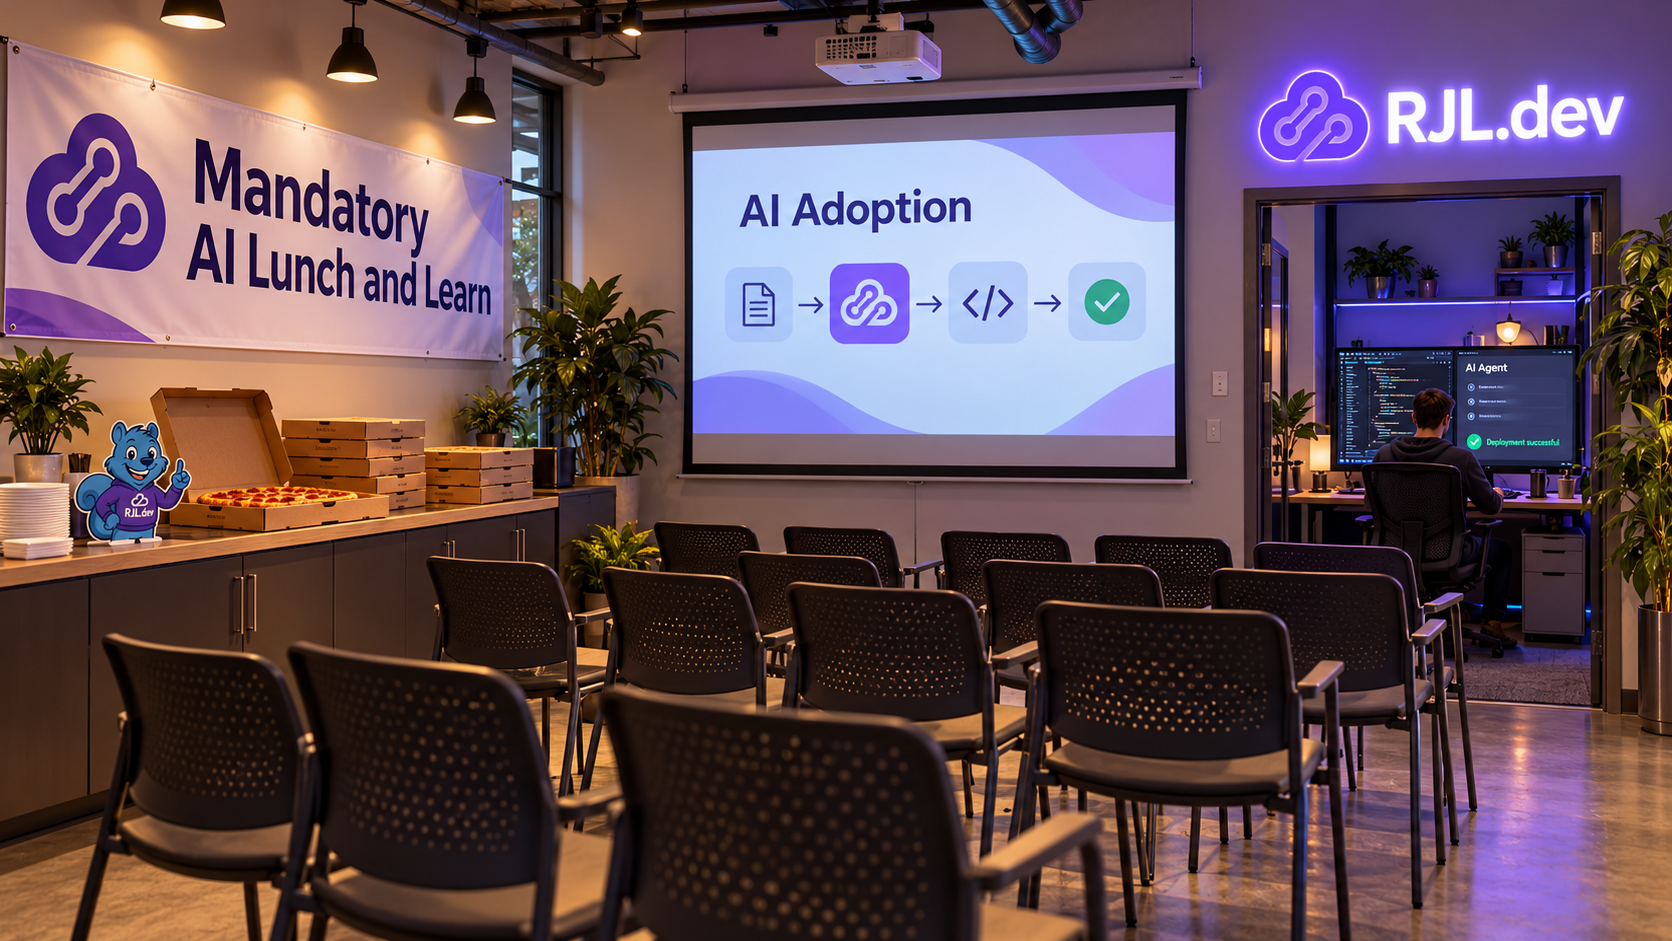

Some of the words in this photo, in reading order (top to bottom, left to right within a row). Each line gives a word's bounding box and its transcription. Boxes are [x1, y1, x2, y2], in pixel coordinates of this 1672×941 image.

[1387, 84, 1625, 144] RJL.dev
[195, 138, 429, 257] Mandatory
[739, 193, 780, 228] AI
[791, 188, 972, 233] Adoption
[186, 223, 235, 285] AI
[248, 233, 354, 300] Lunch
[364, 262, 417, 306] and
[425, 264, 491, 315] Learn
[1465, 363, 1476, 373] AI
[1478, 363, 1508, 375] Agent
[1486, 438, 1526, 447] Deployment
[1526, 438, 1560, 447] successful
